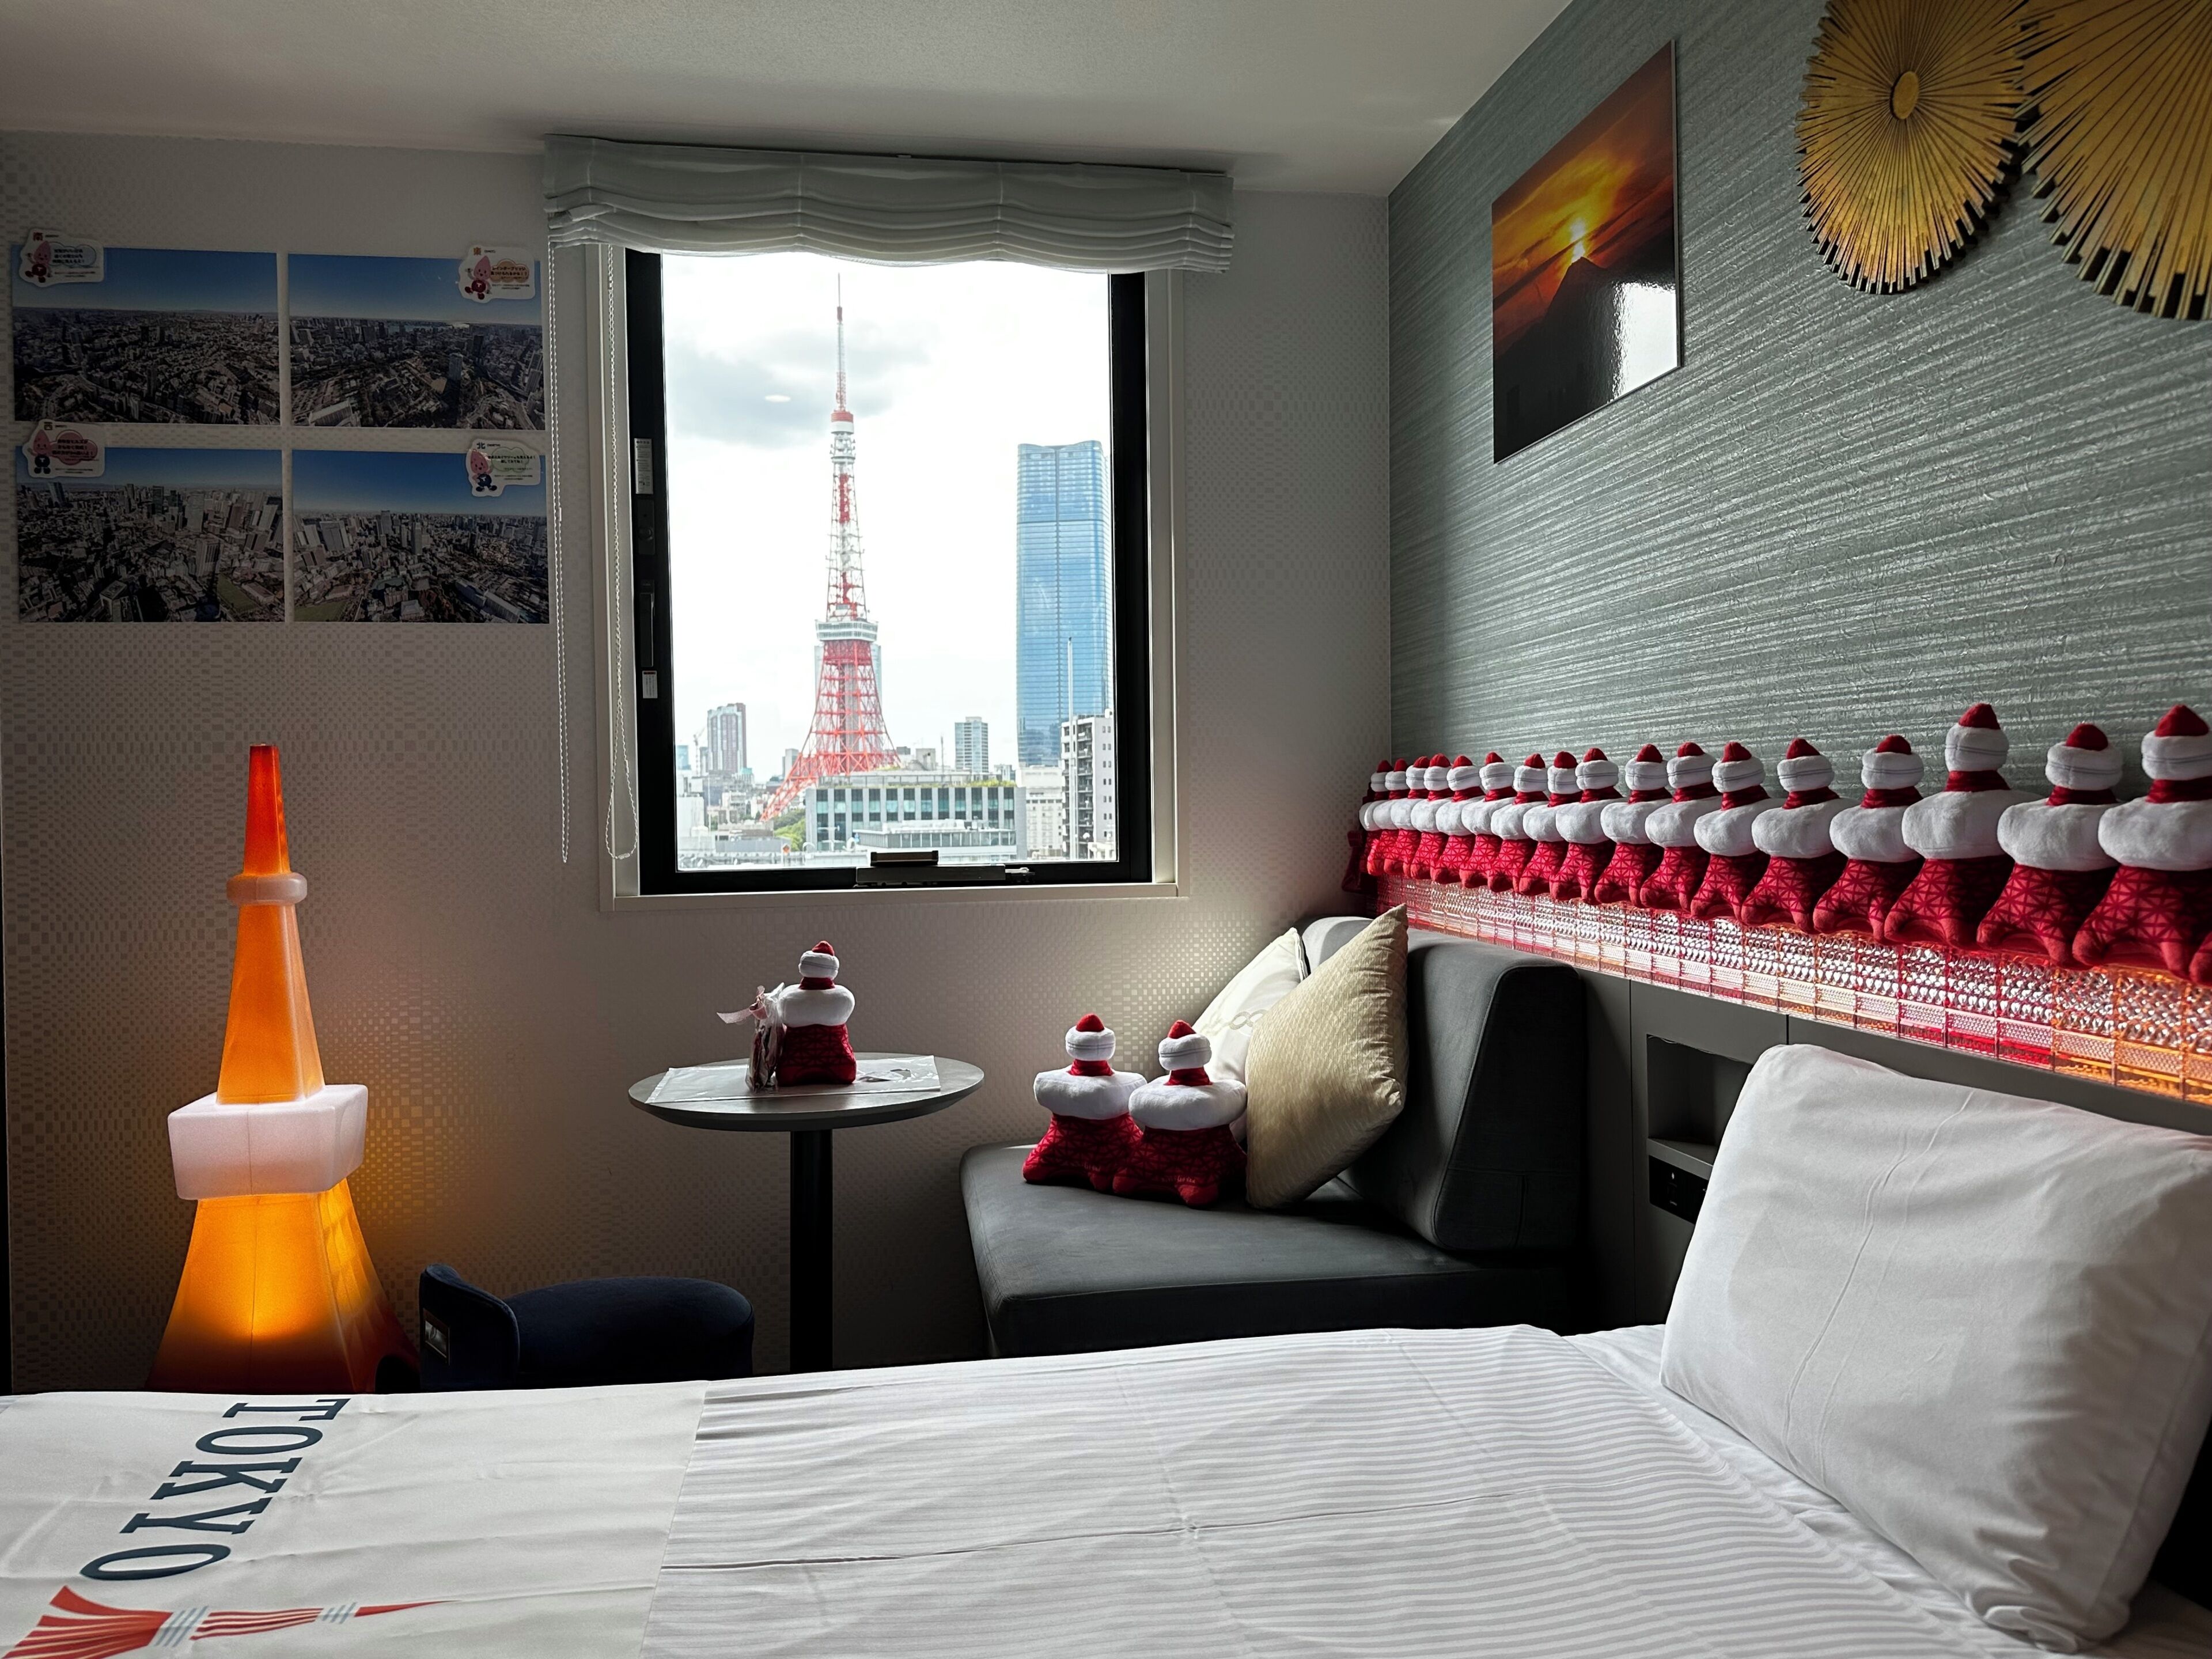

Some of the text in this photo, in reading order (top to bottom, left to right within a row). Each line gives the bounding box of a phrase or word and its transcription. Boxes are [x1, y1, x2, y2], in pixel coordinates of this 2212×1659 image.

[474, 247, 482, 255] 東
[44, 422, 53, 430] 西
[79, 1398, 350, 1581] TOKYO
